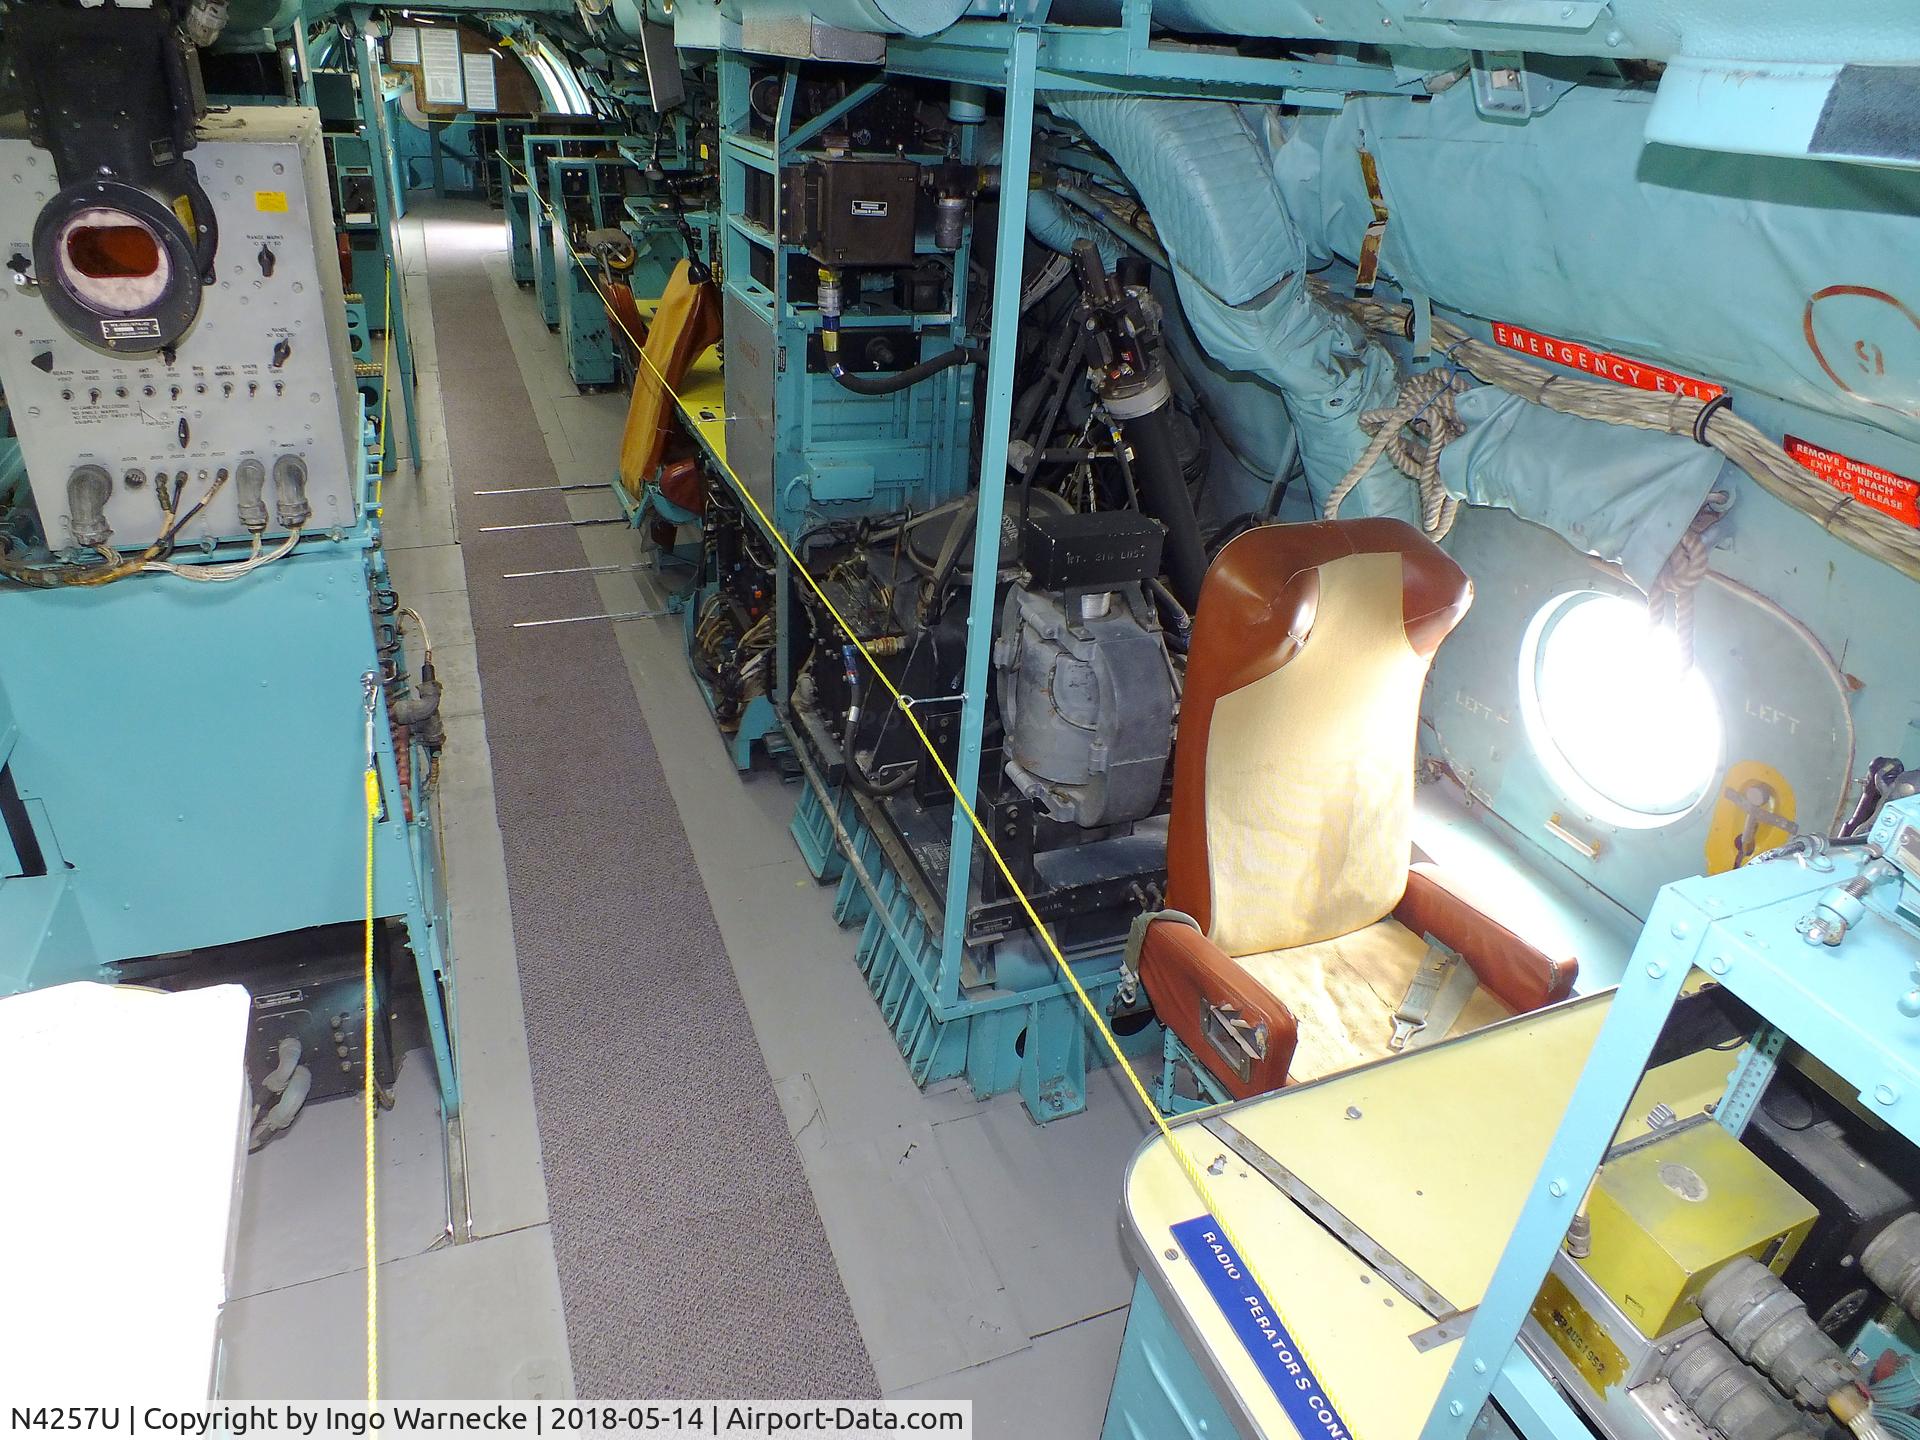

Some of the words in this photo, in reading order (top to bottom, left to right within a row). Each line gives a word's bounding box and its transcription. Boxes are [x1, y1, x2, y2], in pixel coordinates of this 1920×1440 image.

[1498, 327, 1640, 385] EMERGENCY
[1796, 444, 1840, 466] REMOVE
[1846, 462, 1911, 491] EMERGENCY
[1810, 459, 1832, 473] EXIT
[1838, 469, 1852, 480] TO
[1858, 476, 1894, 497] REACH
[1859, 487, 1903, 511] RELEASE
[1455, 690, 1493, 720] LEFT
[1746, 698, 1801, 735] LEFT
[1202, 1231, 1240, 1280] RADIO
